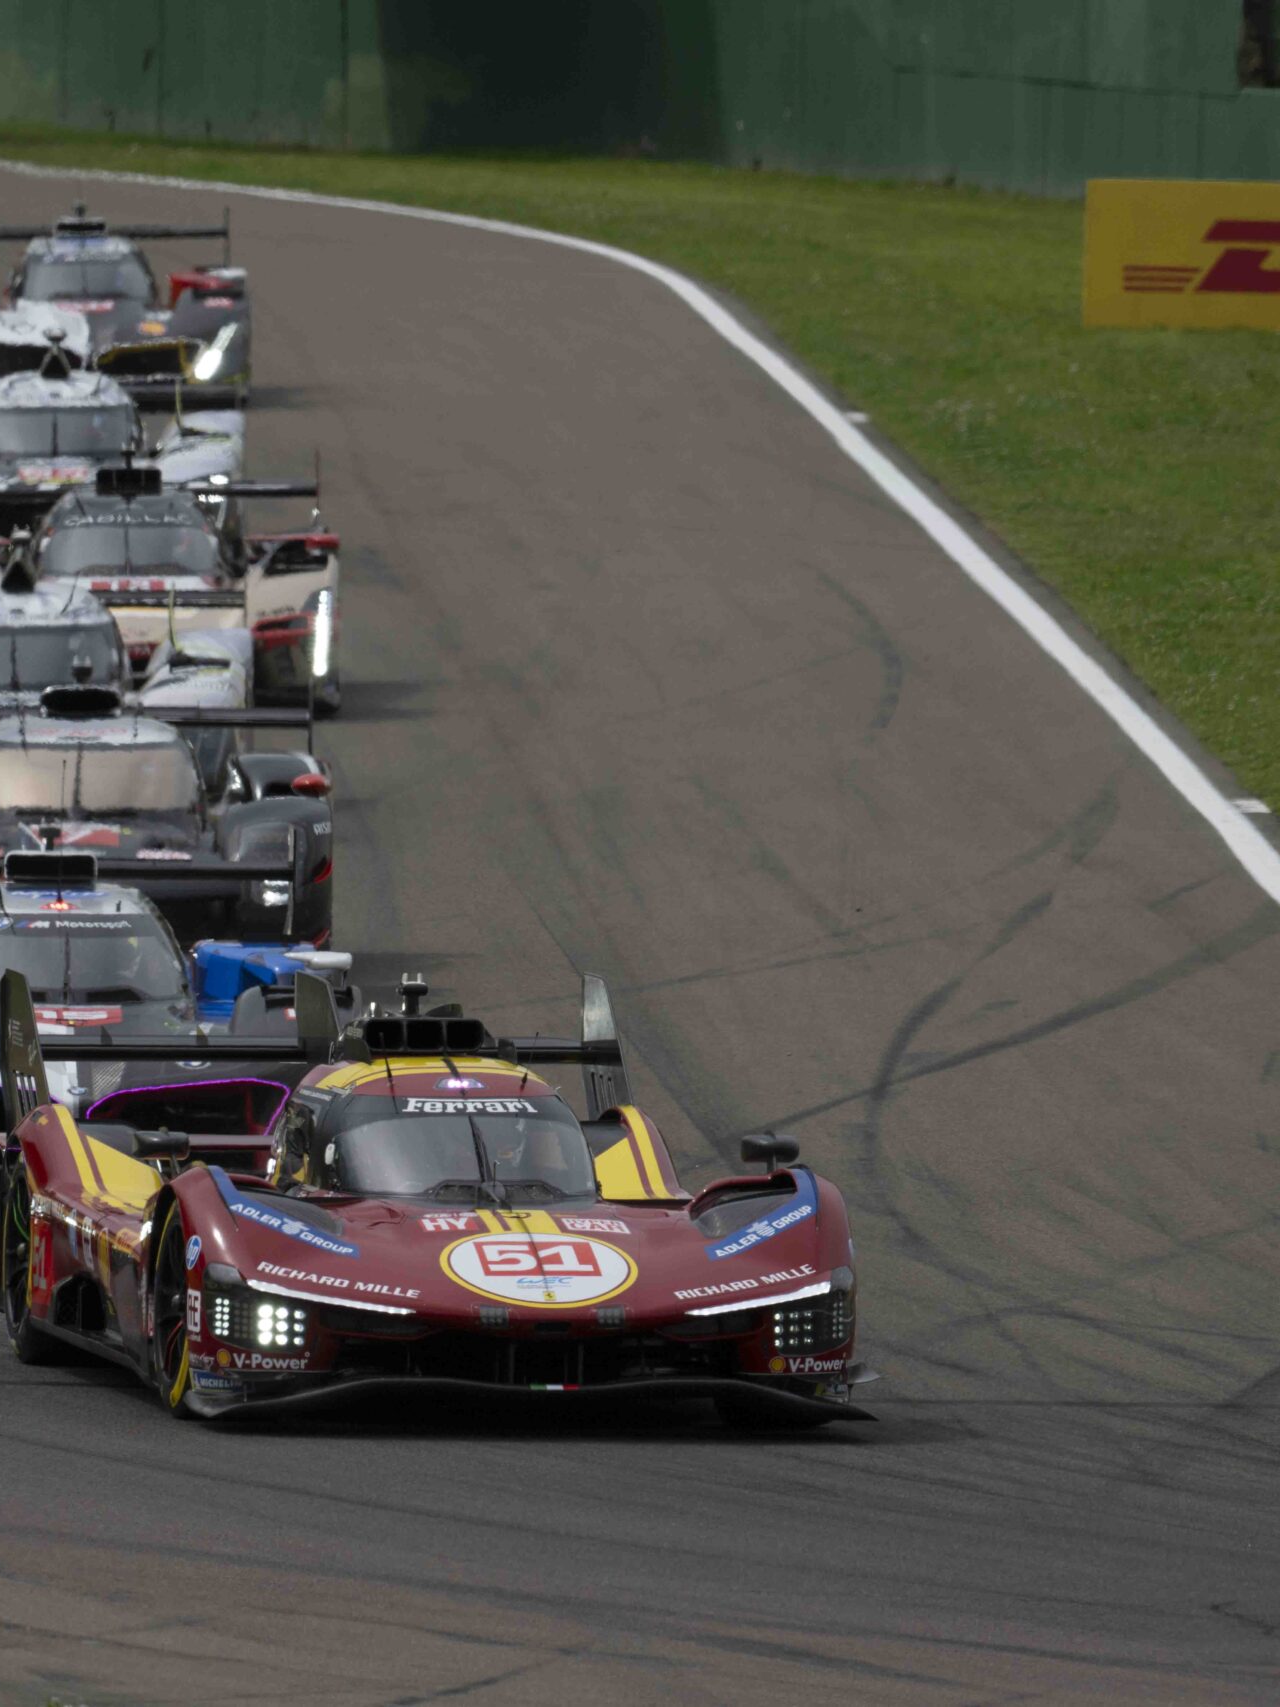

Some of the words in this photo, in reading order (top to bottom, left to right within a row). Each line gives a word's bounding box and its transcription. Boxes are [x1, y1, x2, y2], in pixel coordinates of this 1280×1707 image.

[402, 1098, 539, 1113] Ferrari
[229, 1203, 281, 1228] ADLER
[300, 1231, 354, 1255] GROUP
[421, 1217, 469, 1232] HY
[715, 1234, 761, 1257] ADLER
[772, 1205, 813, 1229] GROUP
[481, 1244, 595, 1272] 51
[257, 1261, 350, 1288] RICHARD
[354, 1282, 421, 1298] MILLE
[516, 1276, 573, 1285] WEC
[674, 1278, 759, 1300] RICHARD
[761, 1263, 816, 1285] MILLE
[233, 1352, 308, 1370] V-Power
[788, 1356, 845, 1373] V-Power
